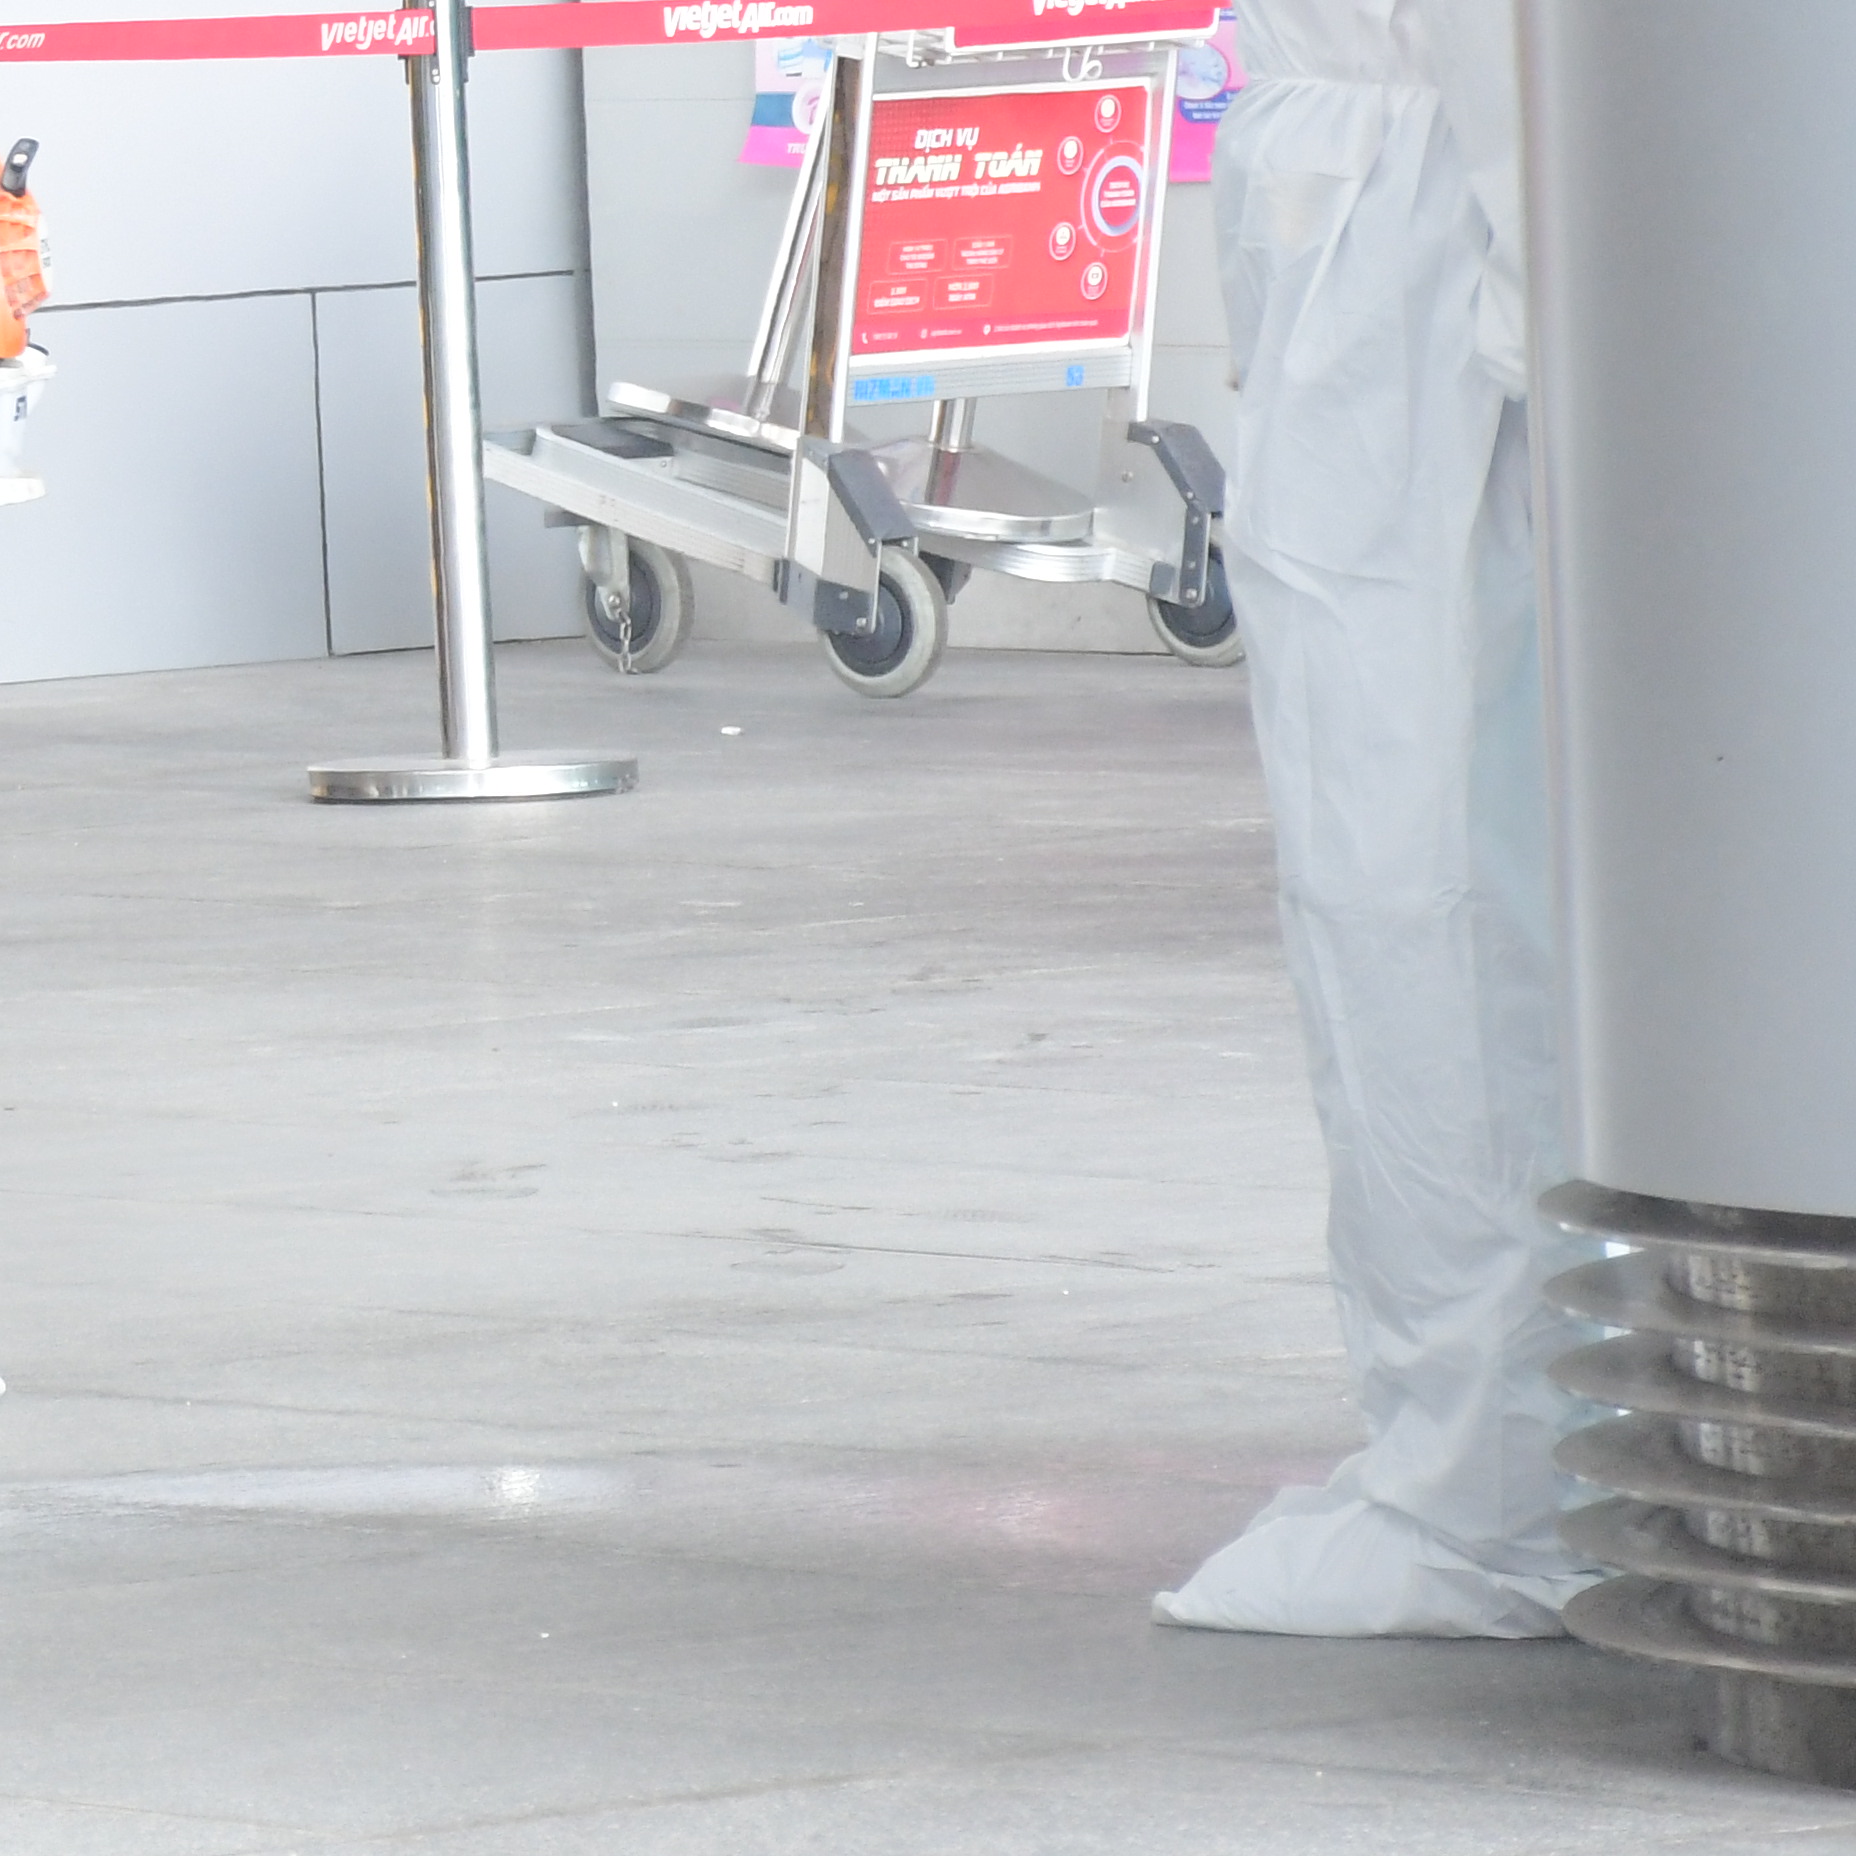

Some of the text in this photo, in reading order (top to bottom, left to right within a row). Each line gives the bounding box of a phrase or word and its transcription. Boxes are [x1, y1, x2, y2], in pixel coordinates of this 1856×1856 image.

[914, 127, 953, 153] DỊCH
[875, 142, 1044, 186] THANH TOÁN
